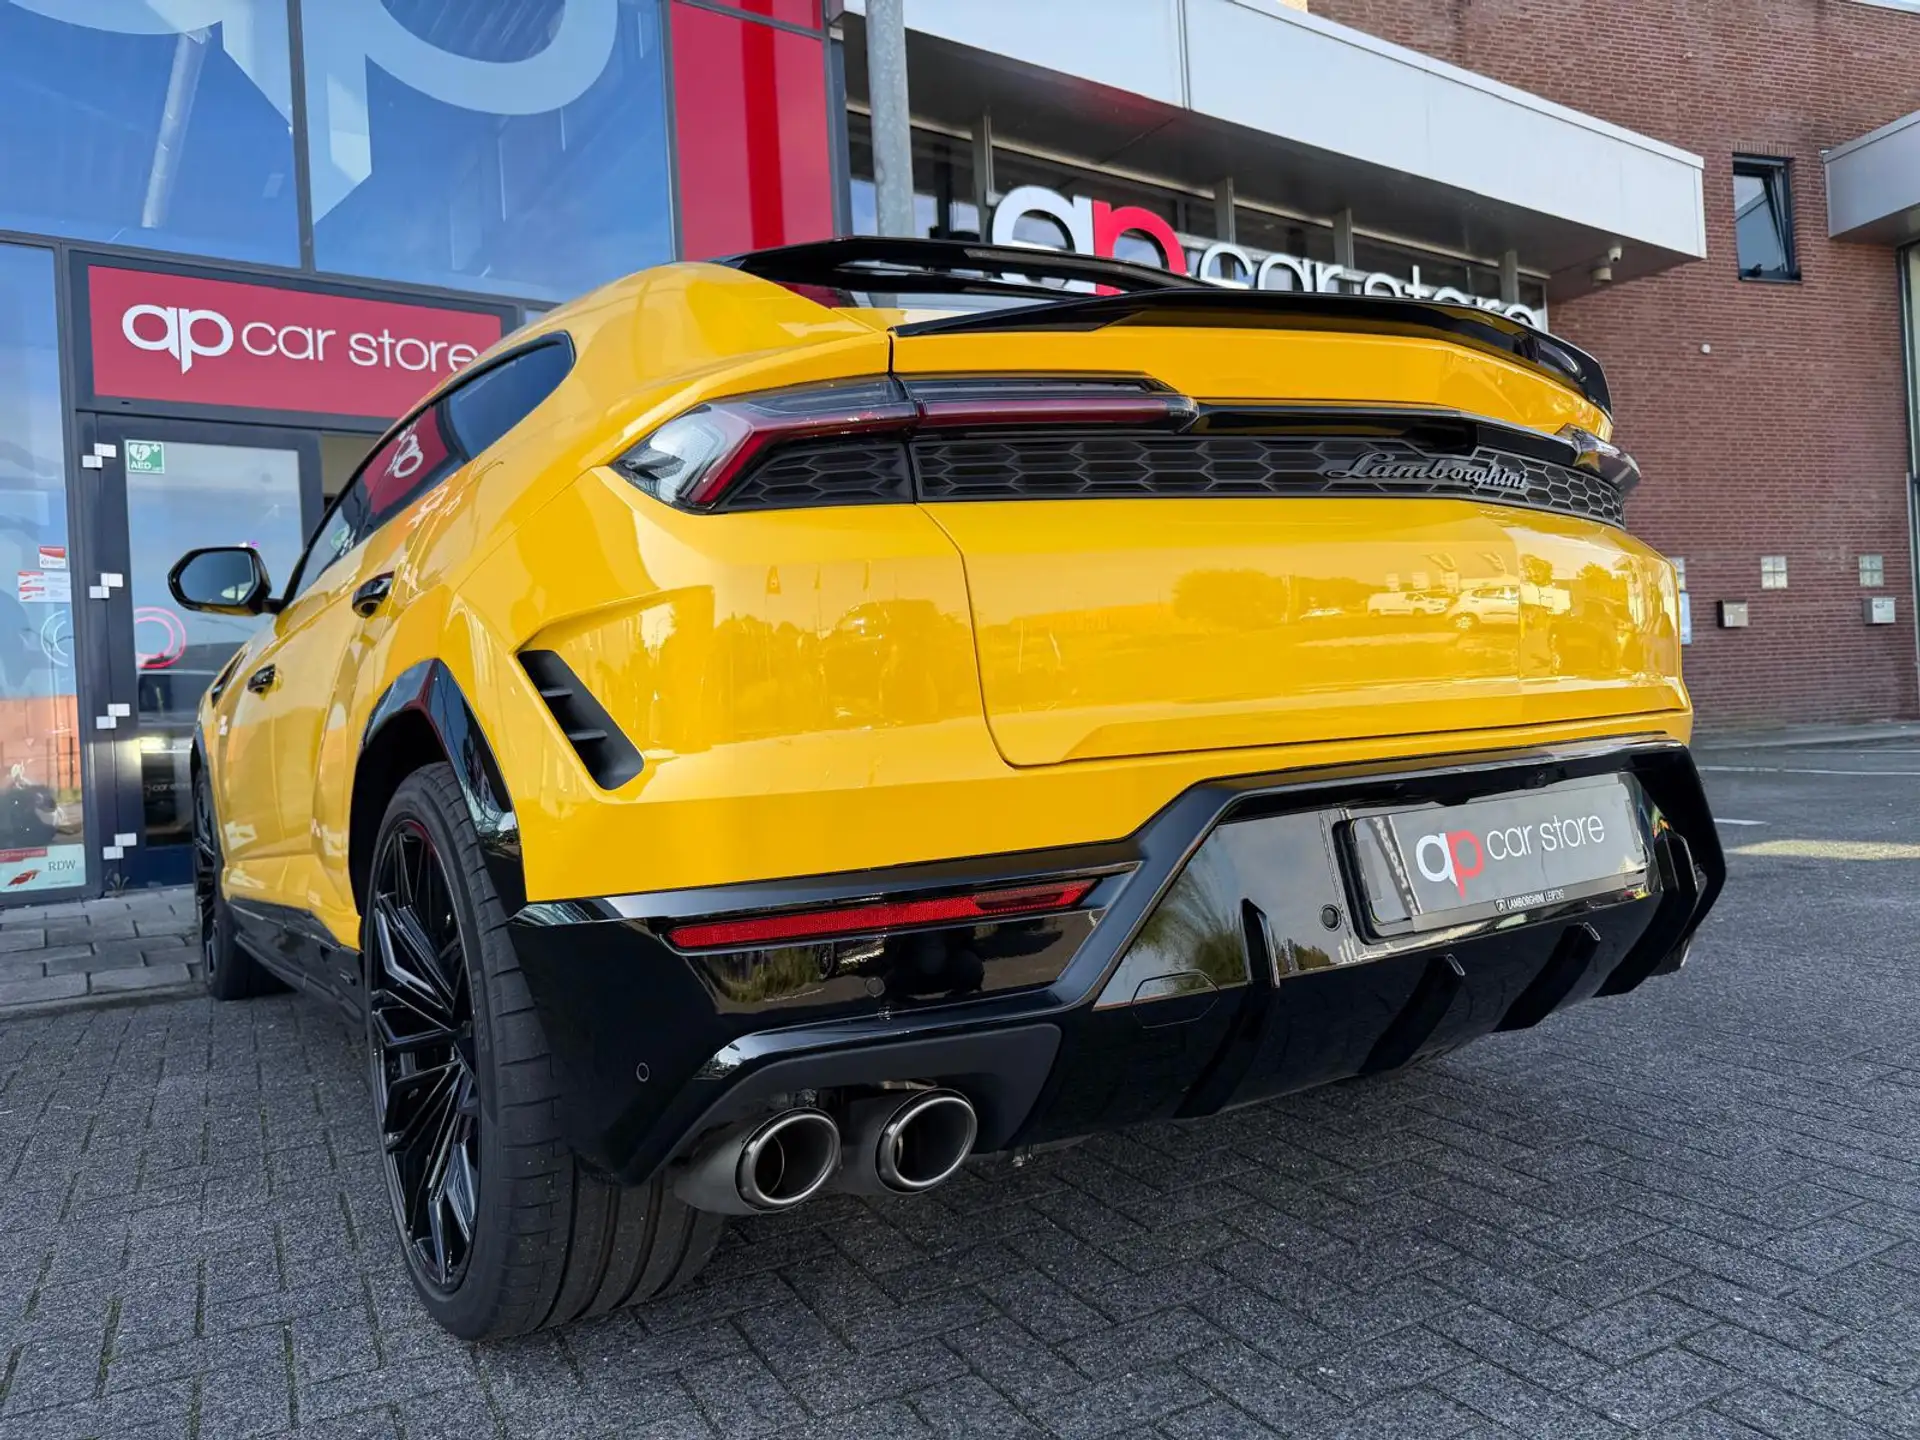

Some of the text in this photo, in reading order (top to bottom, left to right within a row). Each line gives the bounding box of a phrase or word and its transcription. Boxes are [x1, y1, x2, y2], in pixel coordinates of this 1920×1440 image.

[122, 304, 480, 375] ap car store
[131, 461, 152, 470] AED
[1324, 452, 1530, 490] Lamborghini
[48, 859, 76, 872] RDW
[1416, 815, 1605, 899] ap car store
